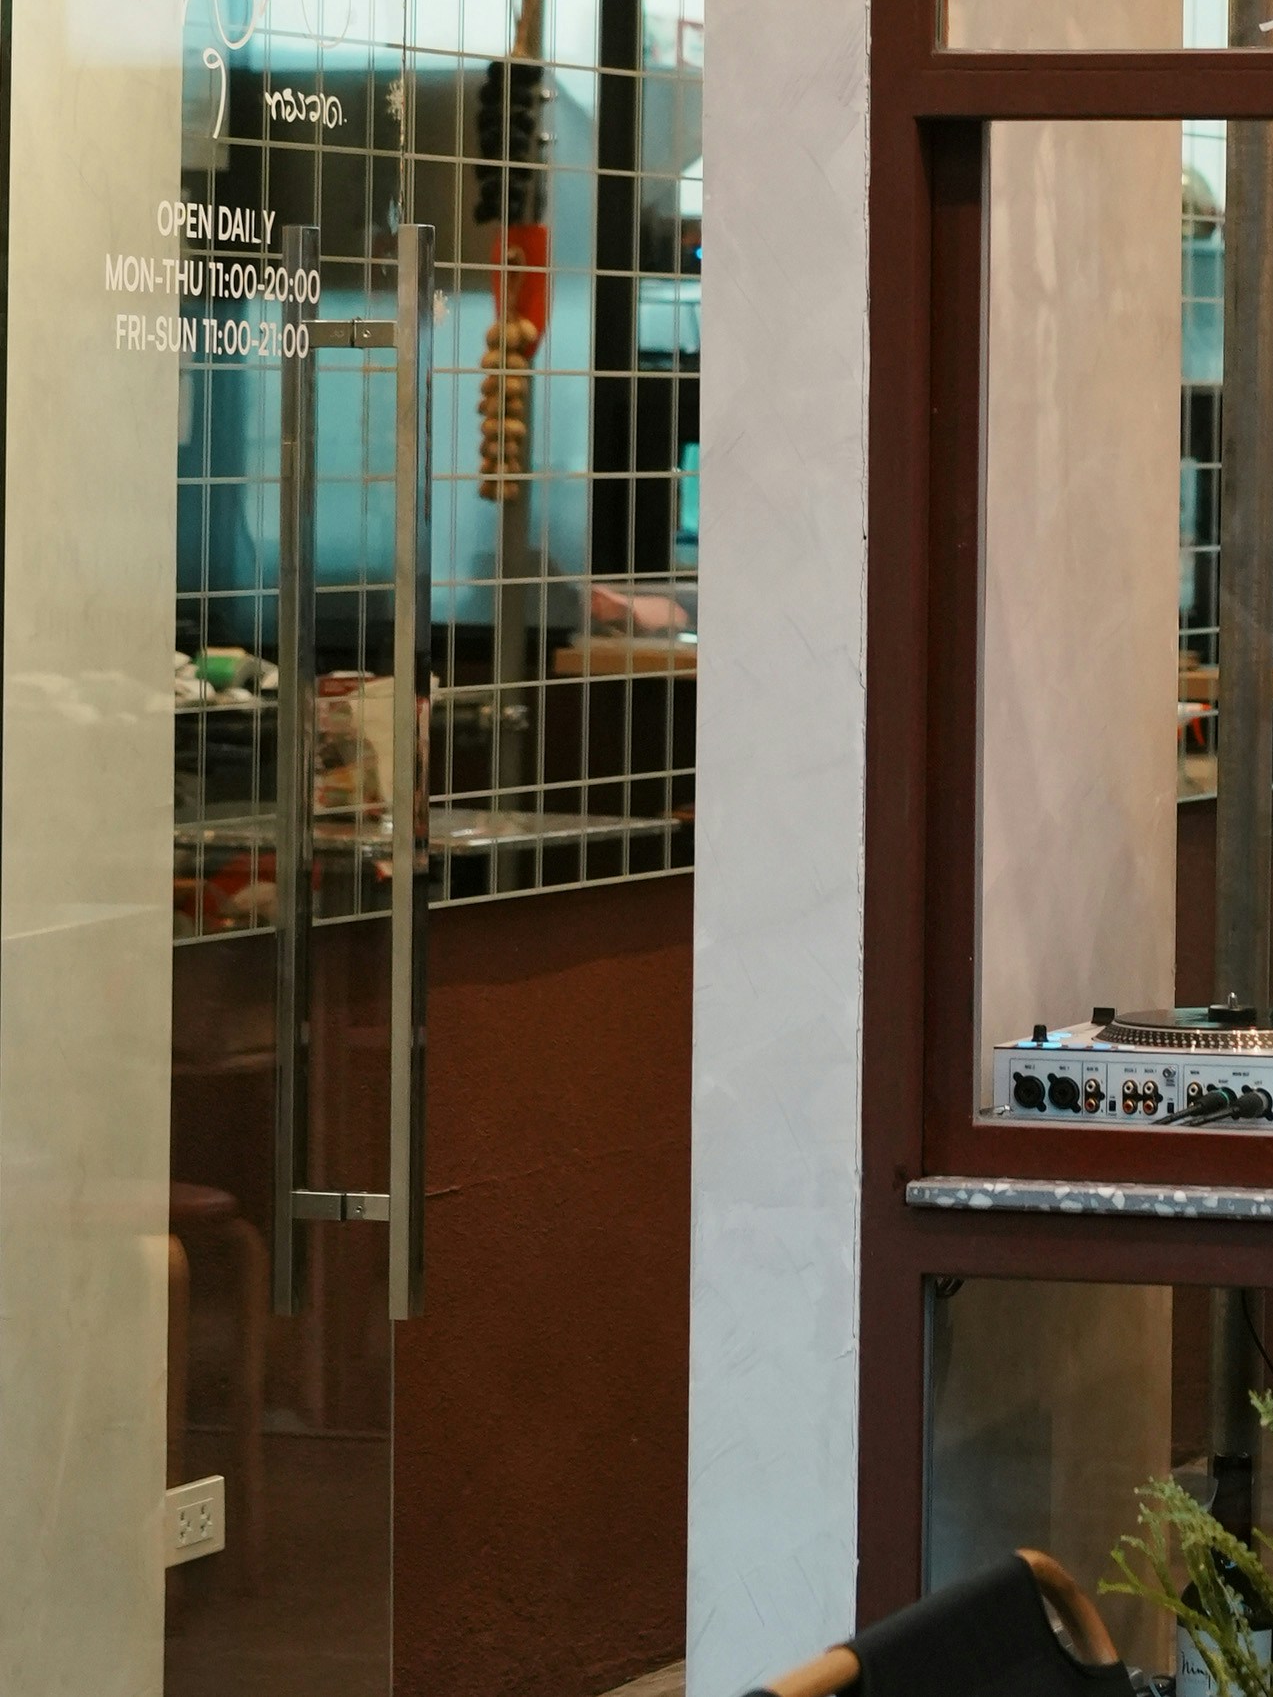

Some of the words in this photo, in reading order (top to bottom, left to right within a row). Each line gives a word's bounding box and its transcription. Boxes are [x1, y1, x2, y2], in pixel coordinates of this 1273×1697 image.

[157, 200, 213, 239] OPEN
[217, 205, 276, 245] DAILY
[105, 254, 204, 298] MON-THU
[208, 262, 321, 304] 11:00-20:00
[116, 314, 198, 354] FRI-SUN
[202, 317, 310, 359] 11:00-21:00
